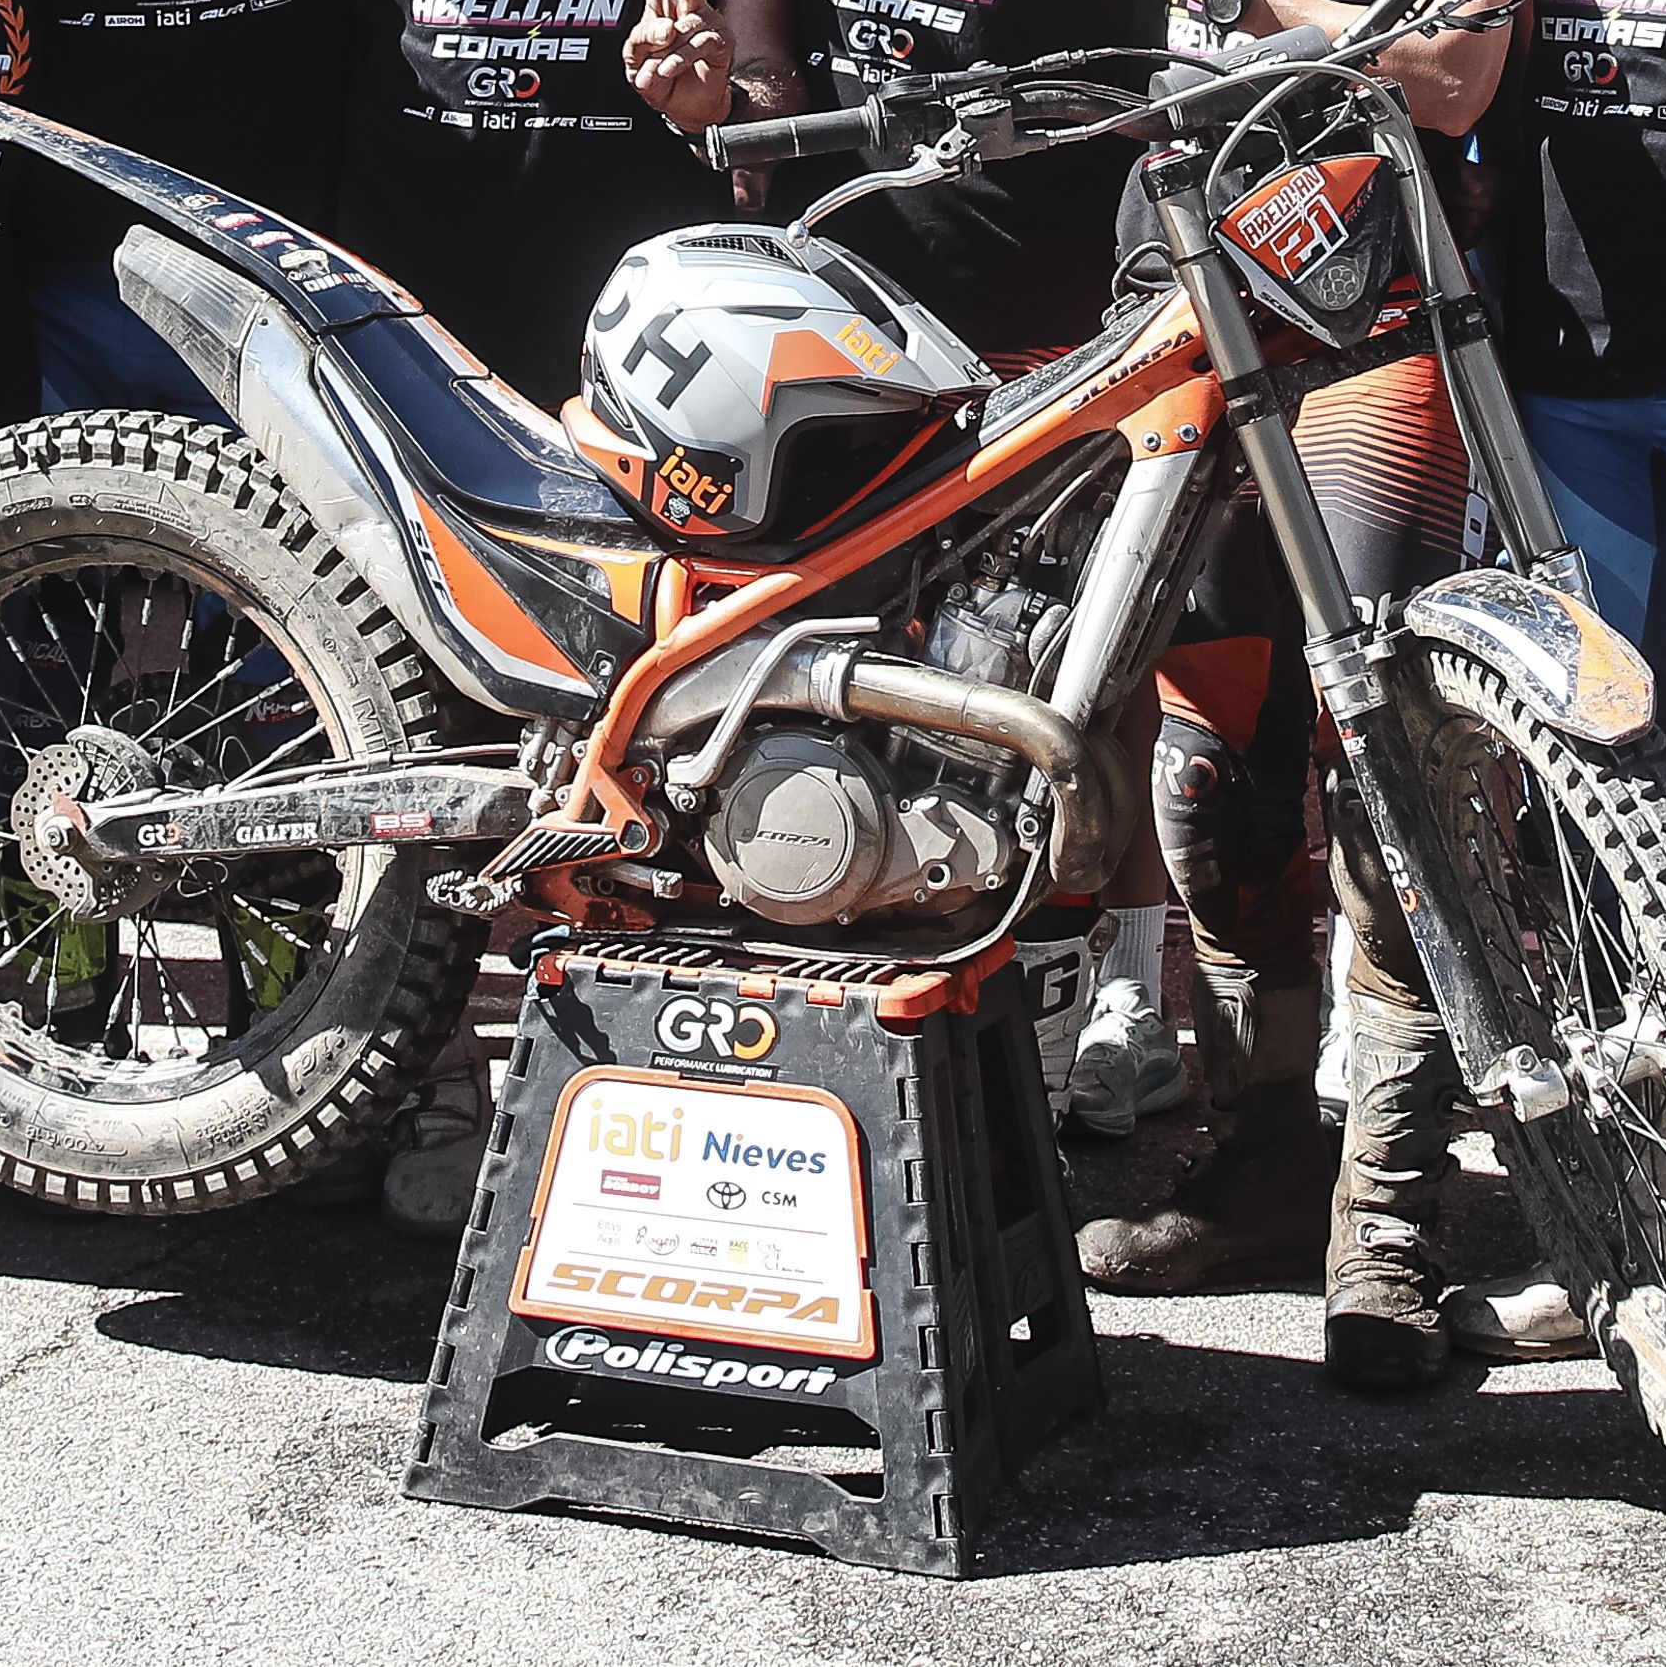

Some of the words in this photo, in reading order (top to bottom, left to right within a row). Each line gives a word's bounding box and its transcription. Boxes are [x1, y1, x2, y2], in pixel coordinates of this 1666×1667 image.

[104, 14, 146, 27] AIROH
[156, 8, 191, 28] iati
[431, 34, 590, 62] COMAS
[847, 18, 914, 59] GRO
[467, 67, 542, 99] GRO
[1564, 52, 1619, 85] GRO
[482, 110, 516, 130] iati
[1236, 165, 1325, 248] ABELLAN
[1260, 290, 1314, 332] SCORPA
[836, 318, 901, 376] iati
[659, 446, 733, 516] iati
[137, 823, 181, 846] GRO
[235, 823, 318, 845] GALFER
[374, 814, 426, 829] BS
[658, 998, 777, 1060] GRO
[654, 1055, 715, 1073] PERFORMANCE
[715, 1063, 773, 1079] LUBRICATION
[589, 1098, 684, 1163] iati
[702, 1130, 827, 1175] Nieves
[761, 1190, 797, 1208] CSM
[546, 1263, 839, 1325] SCORPA
[566, 1329, 837, 1397] Polisport
